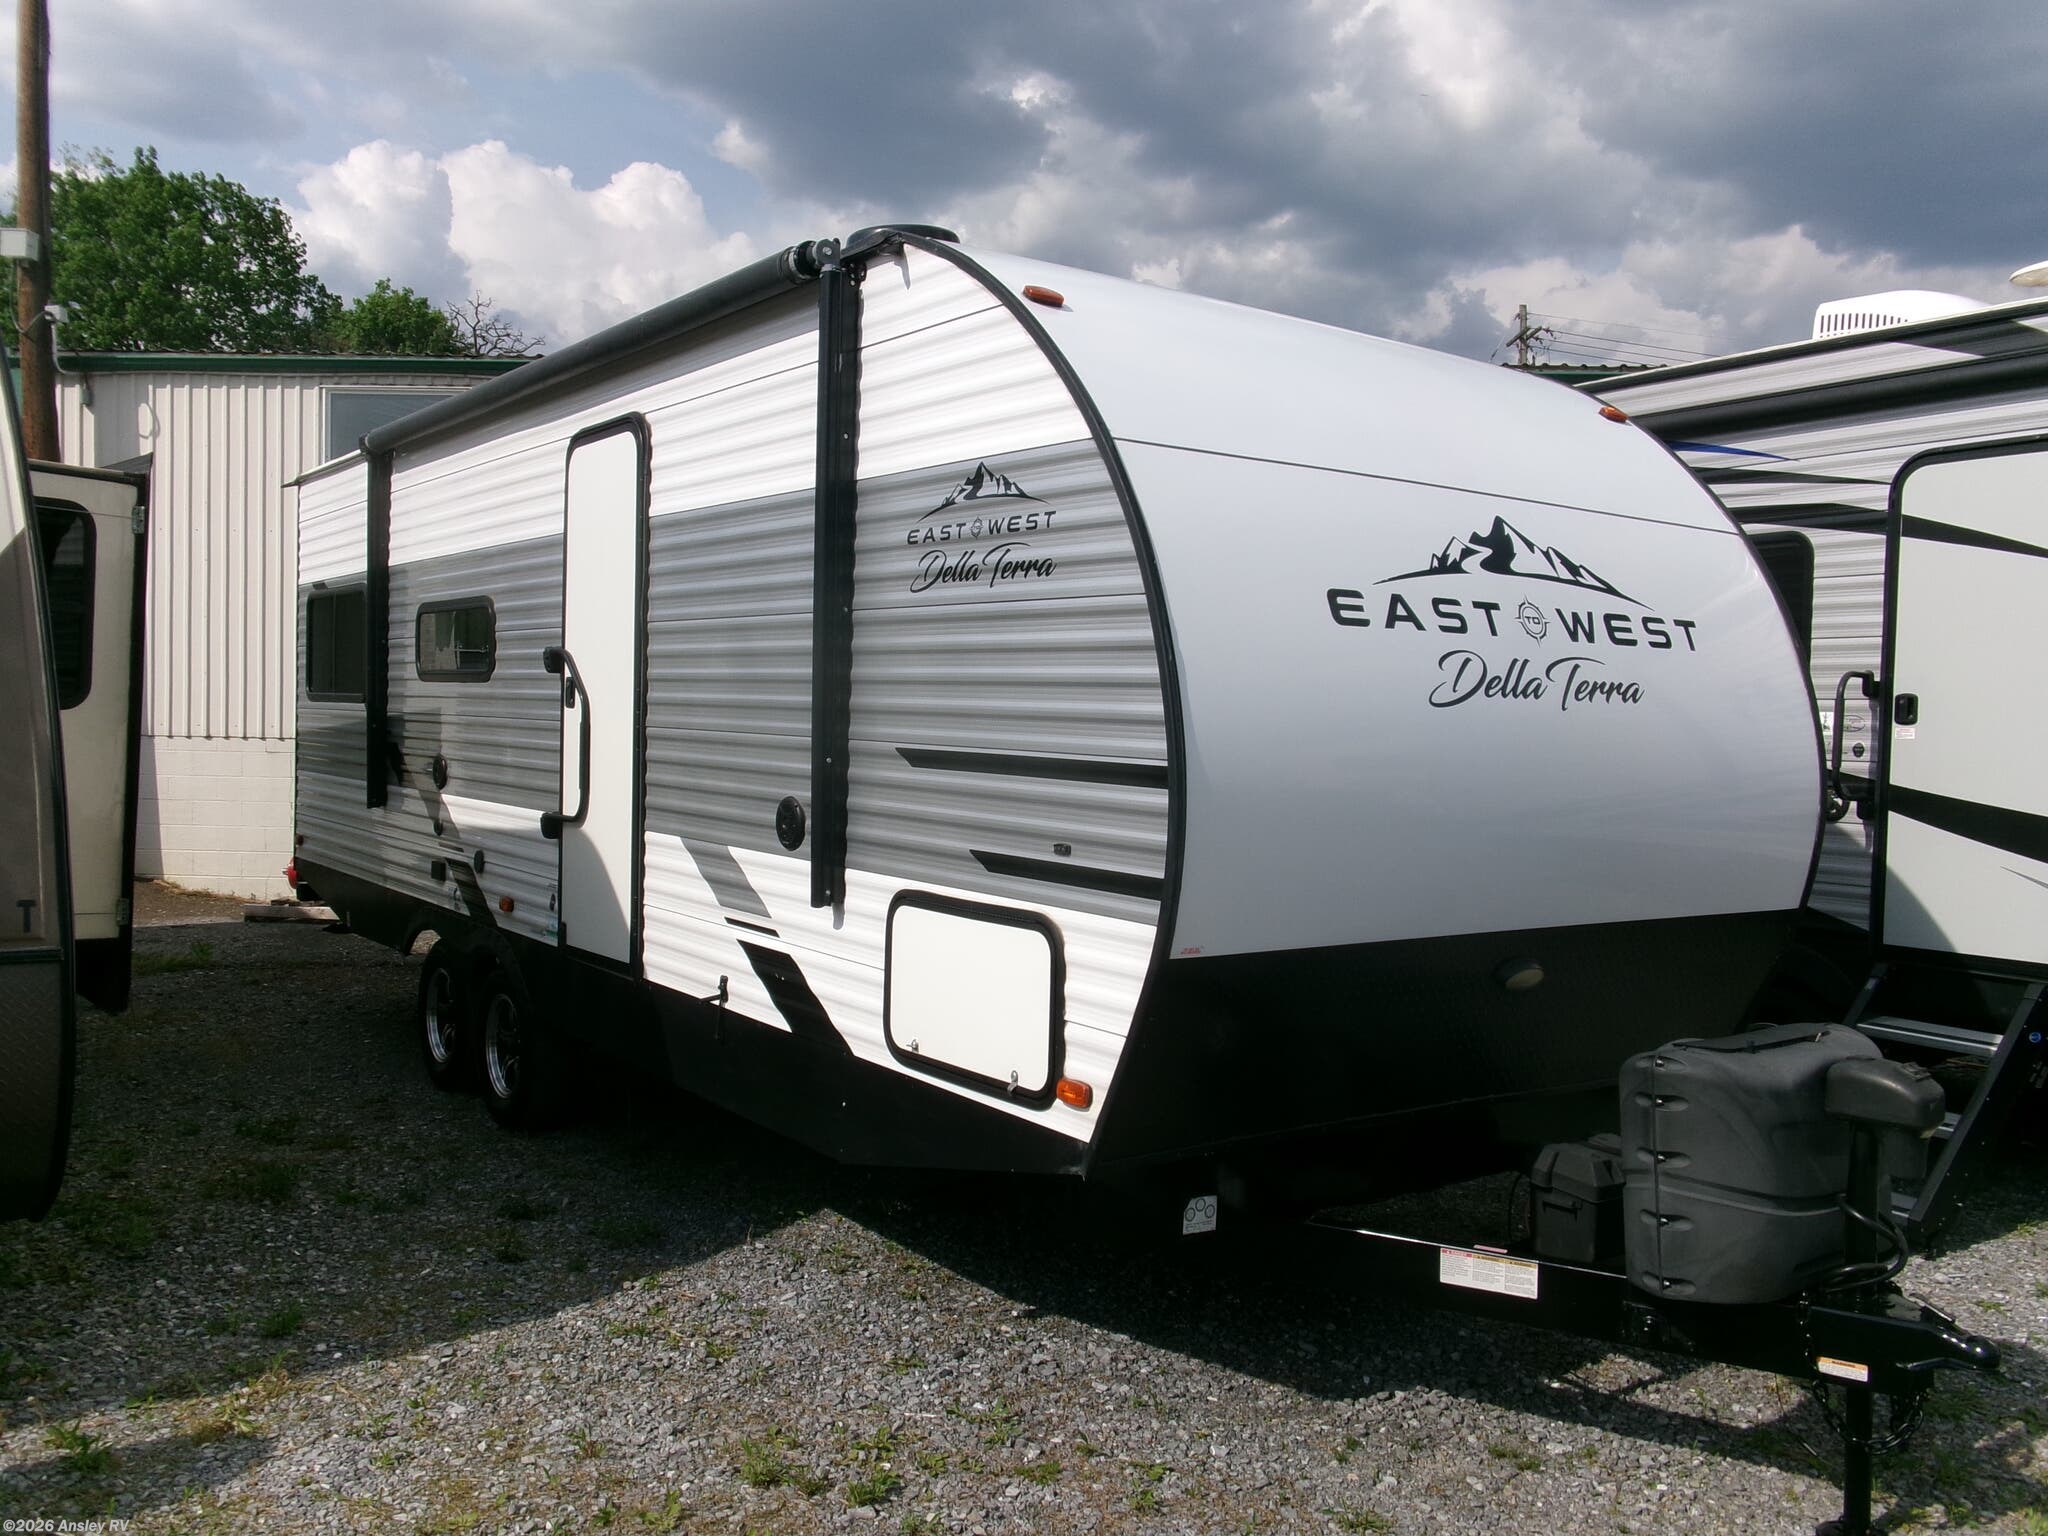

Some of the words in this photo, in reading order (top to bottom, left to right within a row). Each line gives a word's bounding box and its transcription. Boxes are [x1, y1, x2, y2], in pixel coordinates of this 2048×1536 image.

[907, 523, 966, 545] EAST
[988, 511, 1057, 535] WEST
[910, 550, 983, 593] Della
[982, 542, 1058, 588] Terra
[1326, 588, 1500, 637] EAST
[1524, 615, 1541, 625] TO
[1555, 607, 1697, 651] WEST
[1428, 649, 1547, 718] Della
[1545, 656, 1646, 721] Terra
